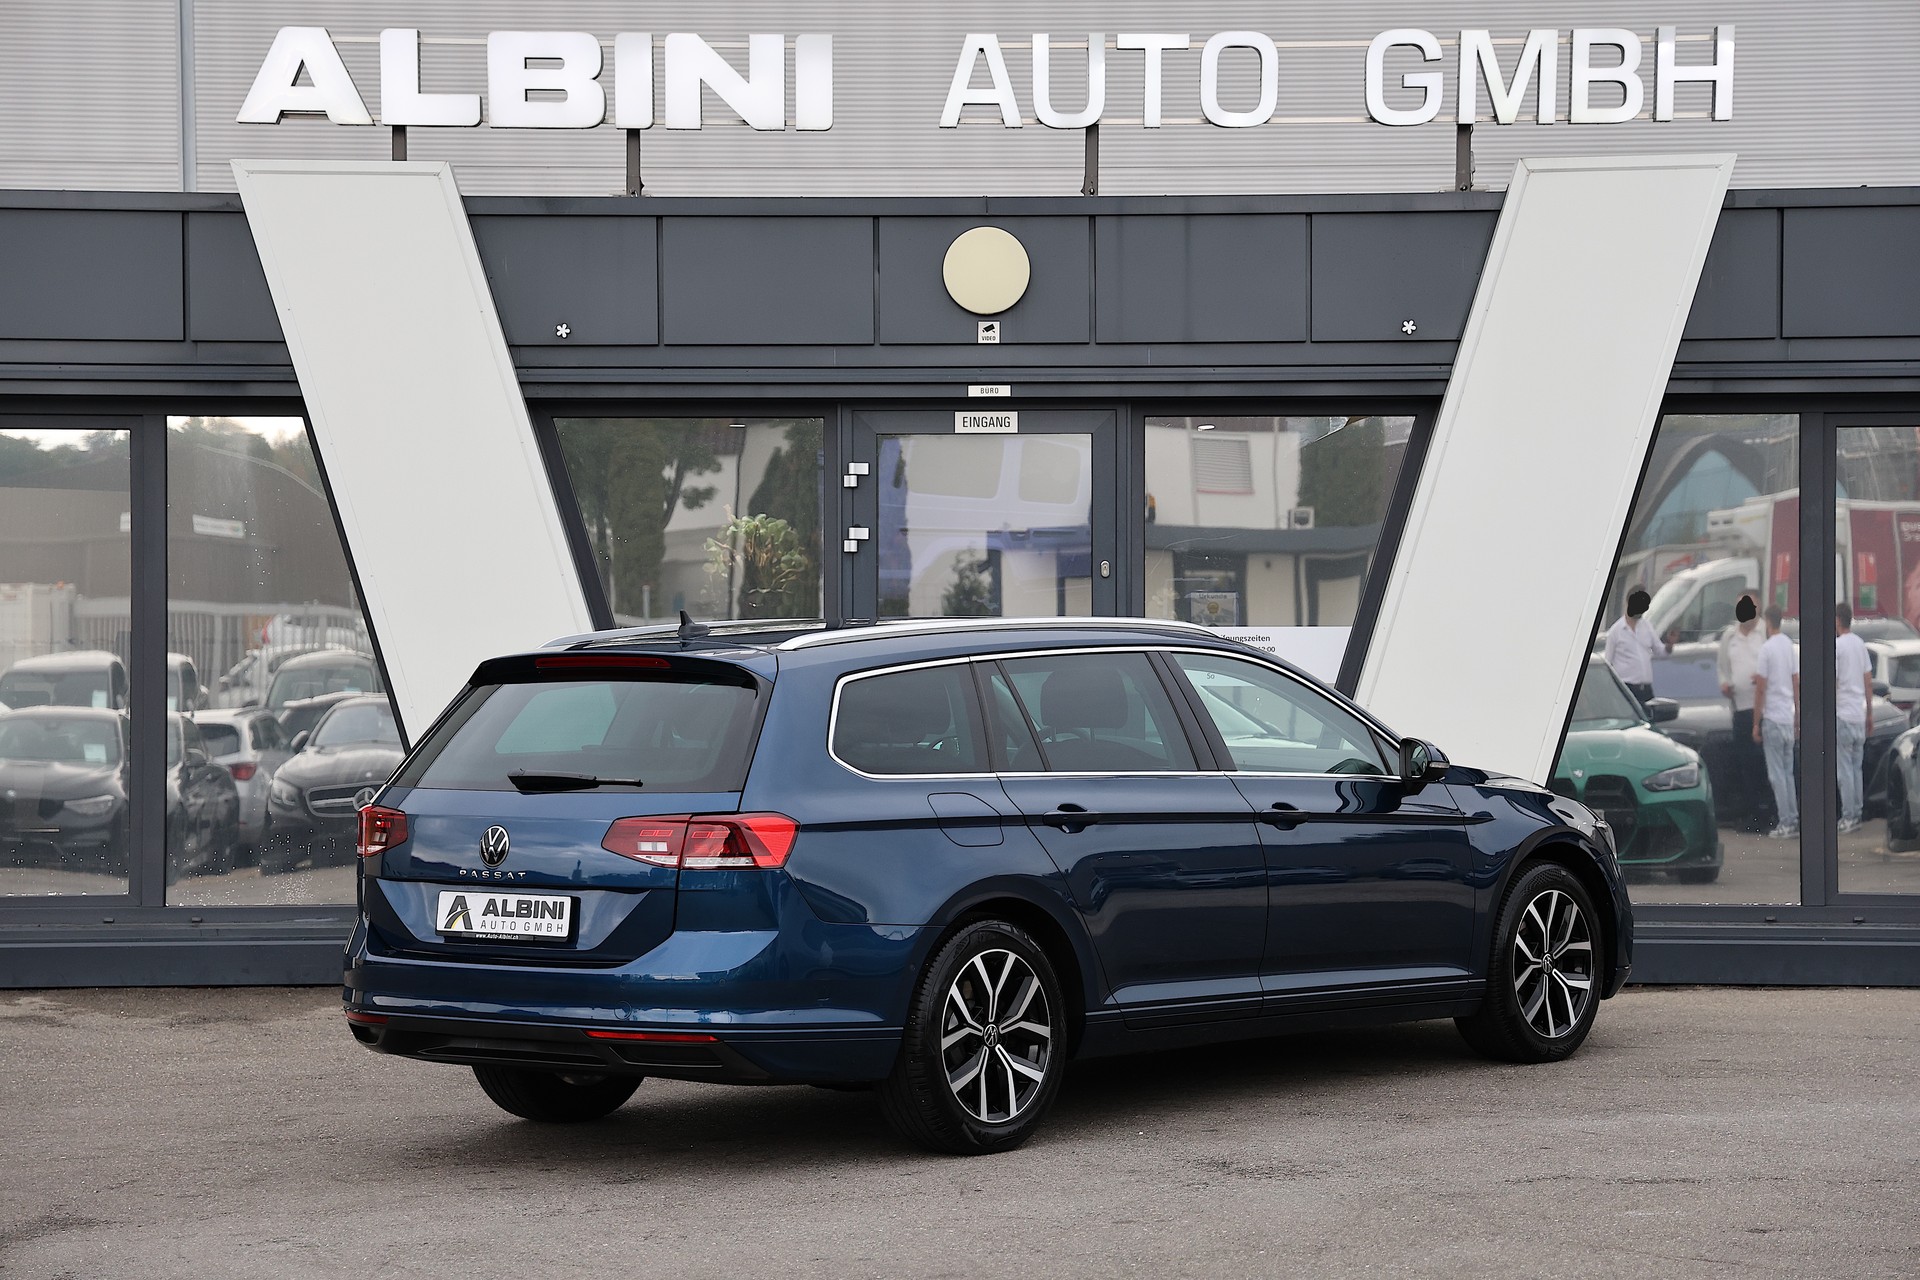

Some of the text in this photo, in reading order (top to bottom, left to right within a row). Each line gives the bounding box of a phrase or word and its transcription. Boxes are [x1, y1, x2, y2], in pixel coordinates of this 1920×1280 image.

[236, 25, 1735, 132] ALBINI AUTO GMBH
[980, 386, 999, 394] BÜRO
[962, 416, 1011, 428] EINGANG
[1221, 634, 1270, 642] nungszeiten
[459, 869, 526, 880] PASSAT
[482, 898, 565, 920] ALBINI
[480, 920, 563, 933] AUTO GMBH
